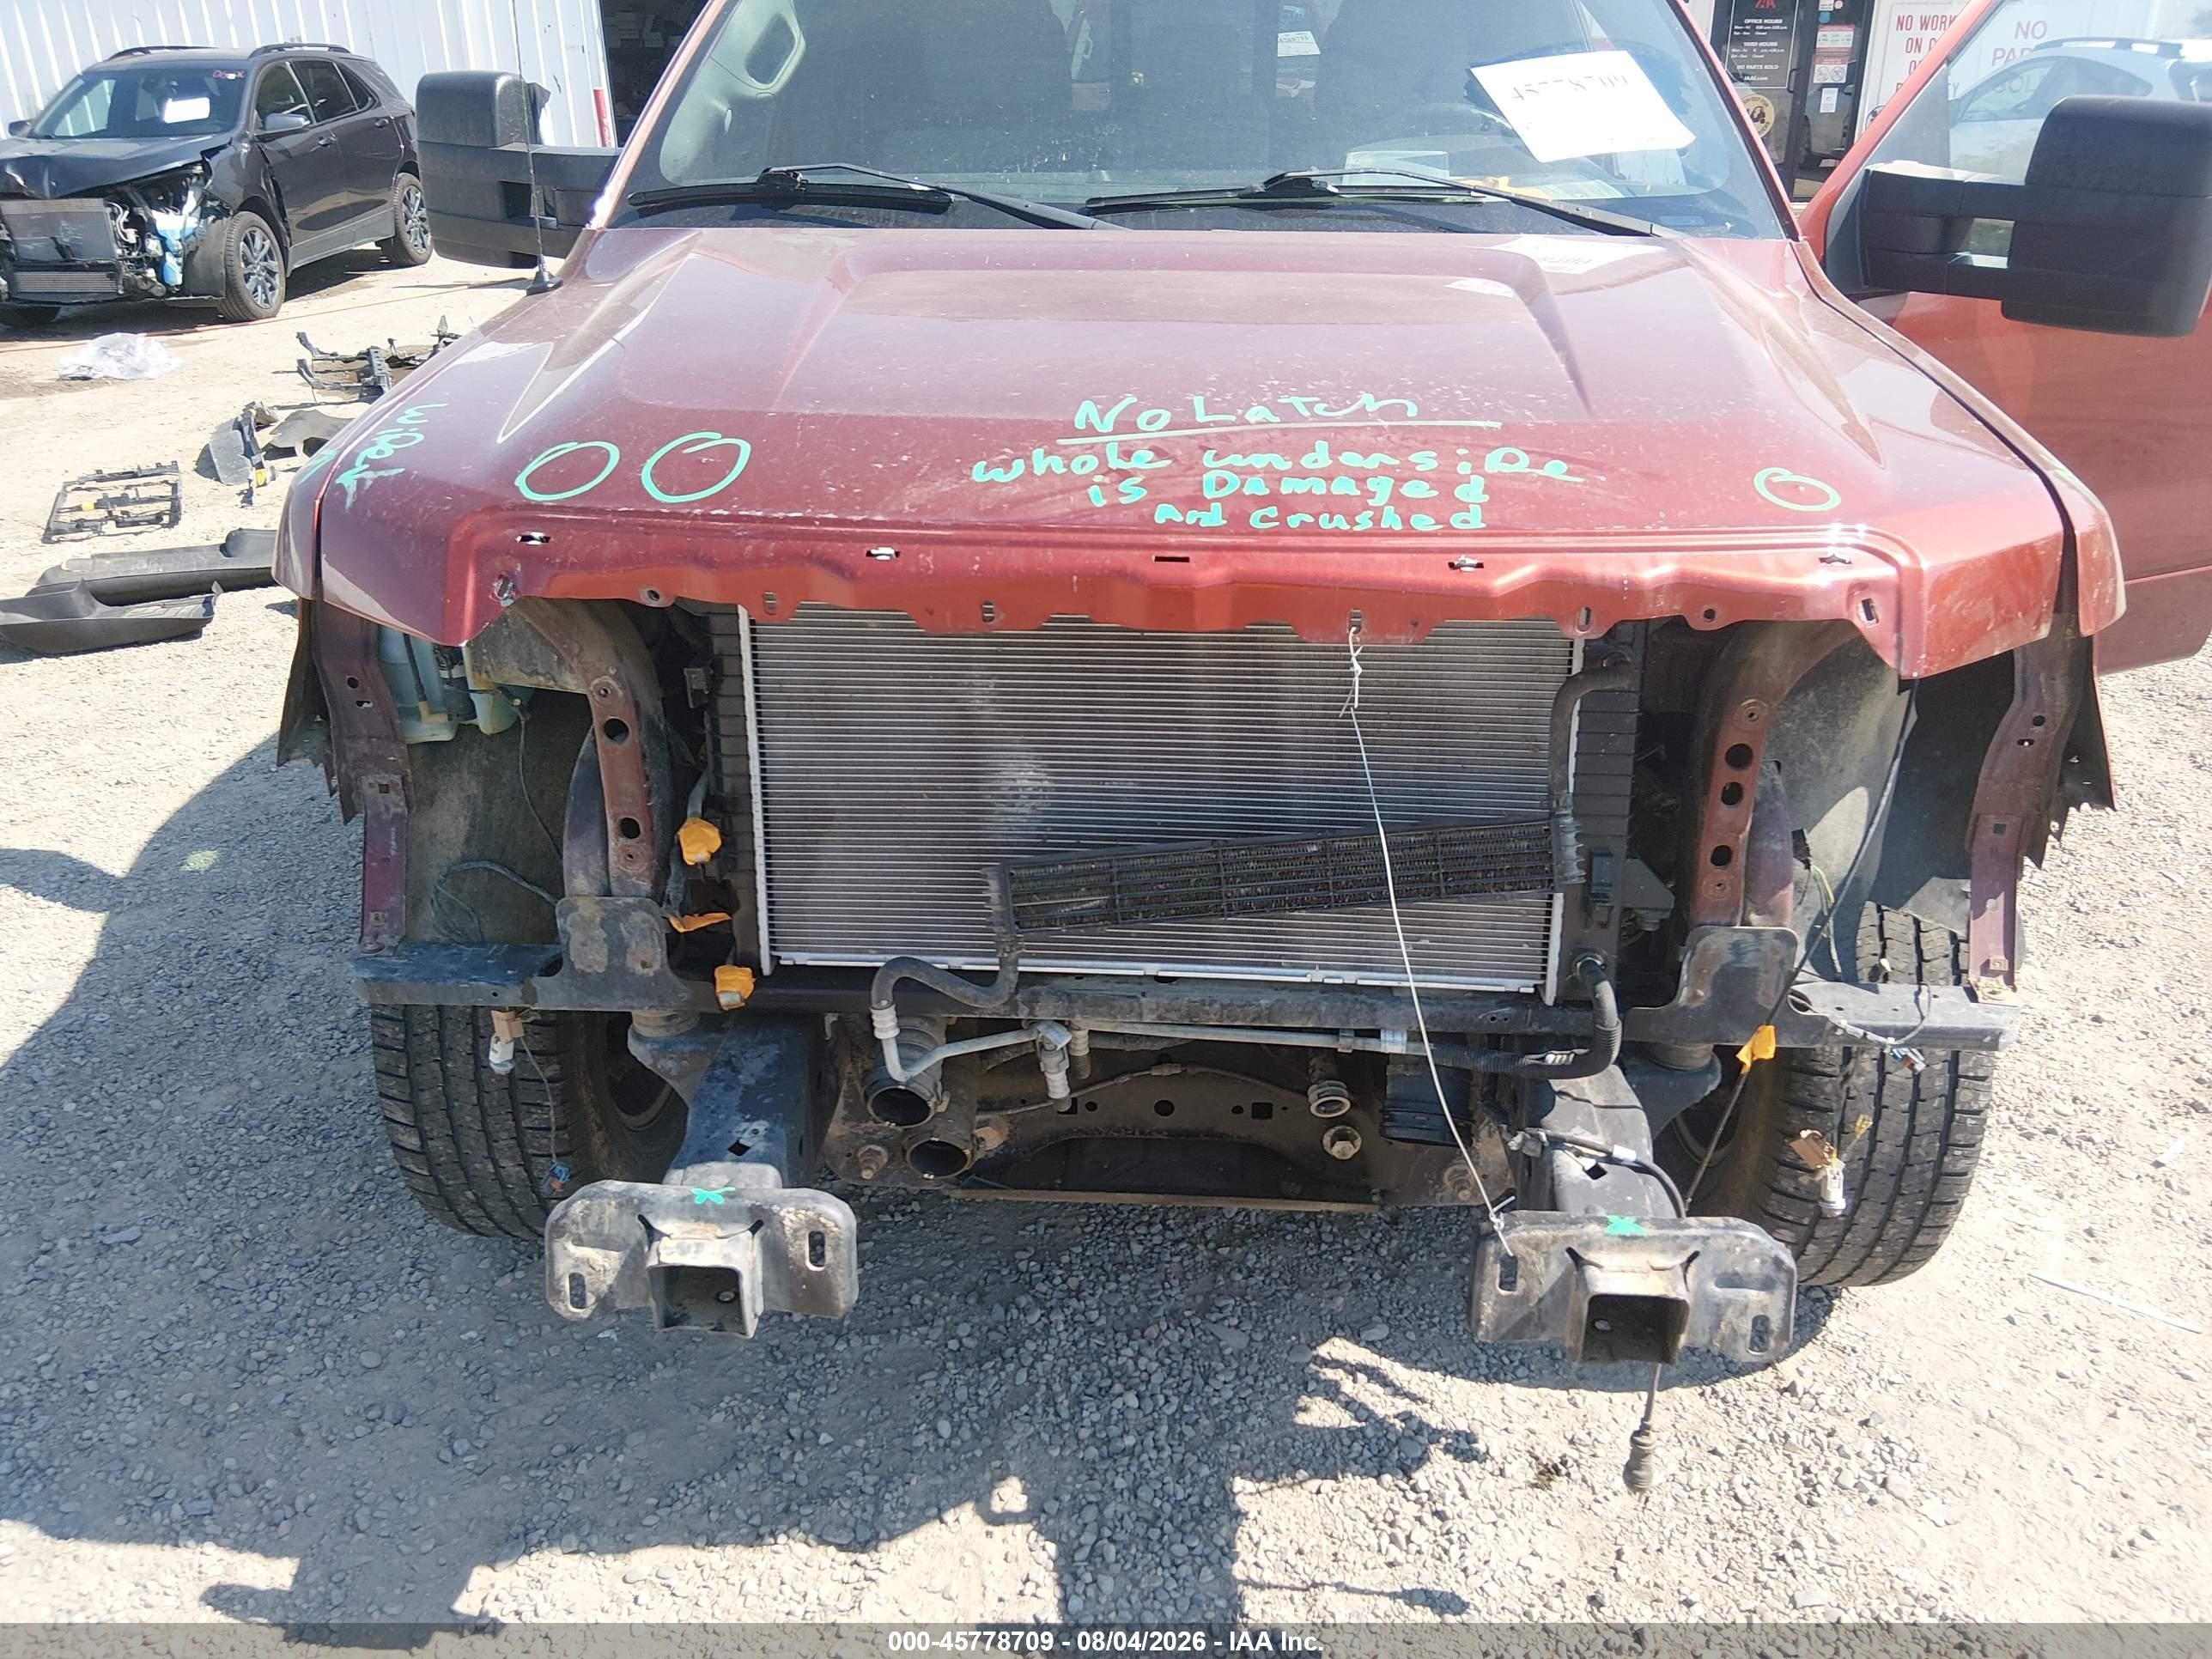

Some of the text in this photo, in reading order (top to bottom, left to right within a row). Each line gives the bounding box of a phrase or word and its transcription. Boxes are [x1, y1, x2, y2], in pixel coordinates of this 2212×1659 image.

[1896, 15, 1914, 31] NO
[2014, 21, 2048, 40] NO
[1905, 38, 1923, 53] ON
[1086, 475, 1148, 508] is
